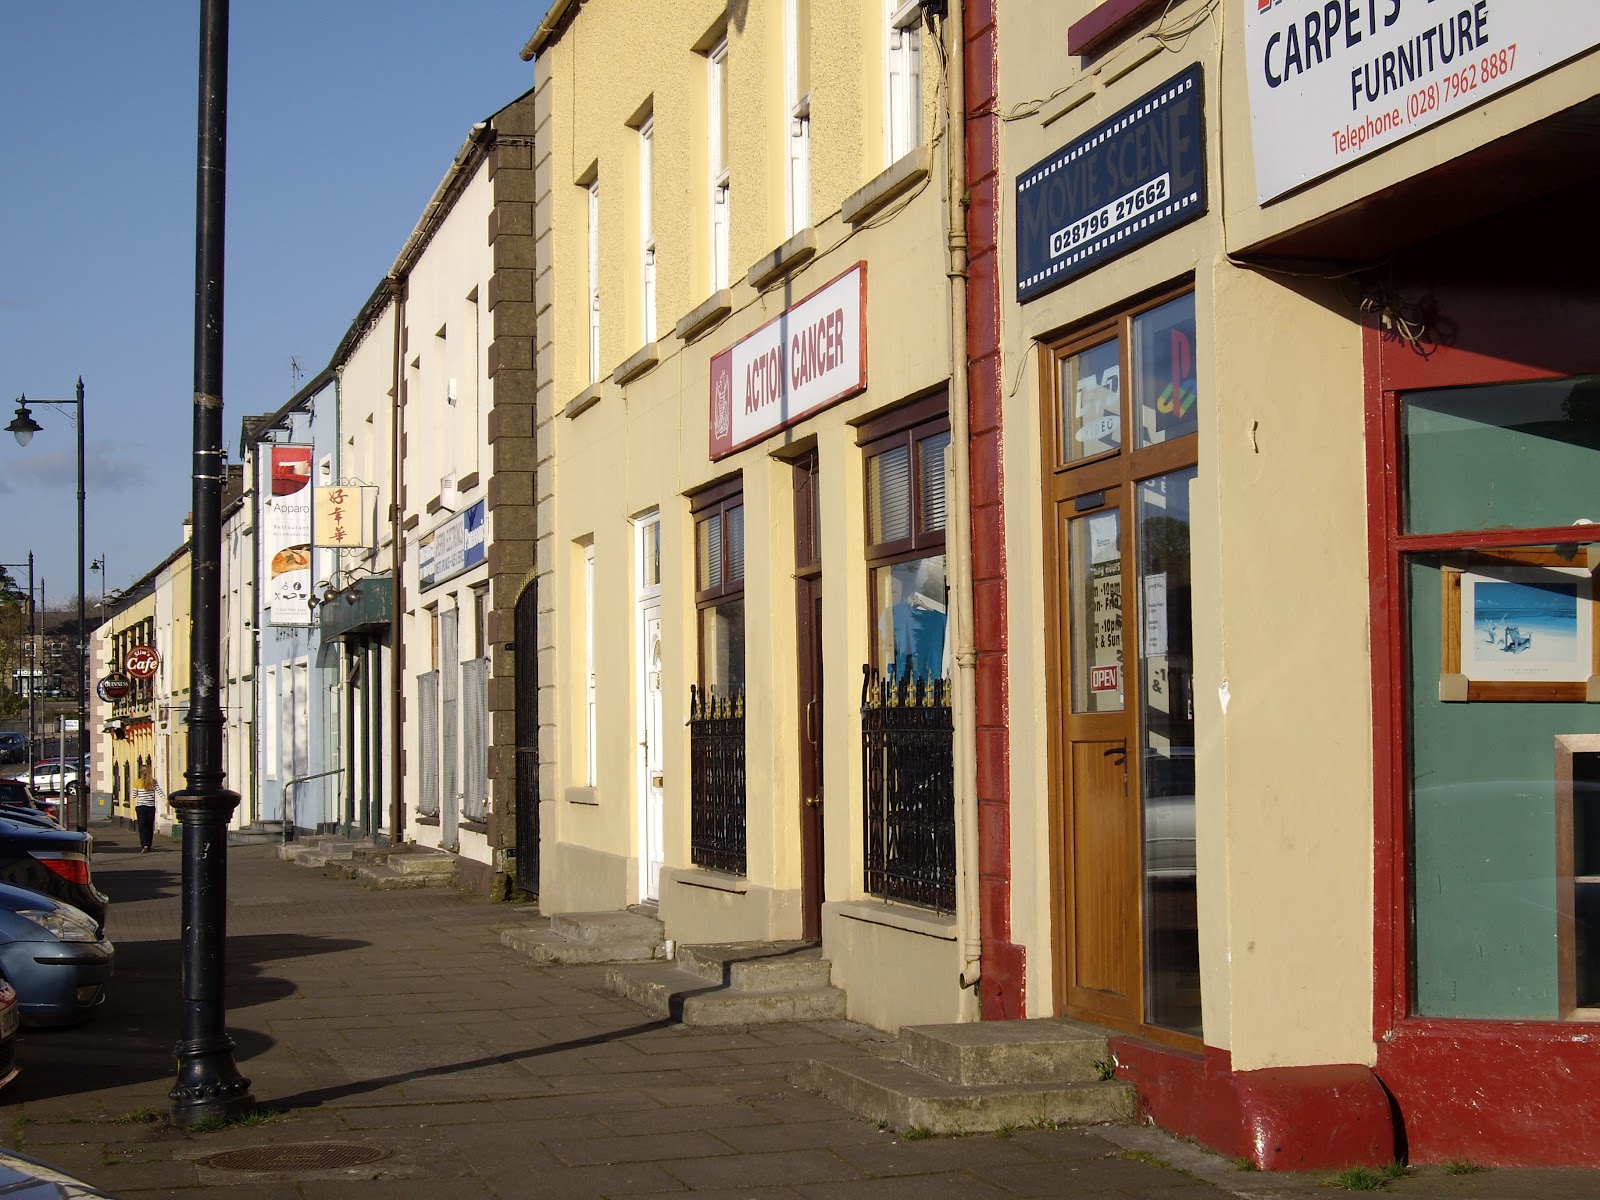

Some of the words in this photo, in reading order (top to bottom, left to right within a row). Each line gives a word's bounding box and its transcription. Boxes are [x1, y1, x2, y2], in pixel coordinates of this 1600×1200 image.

[1265, 0, 1401, 88] CARPETS
[1351, 0, 1489, 111] FURNITURE
[1332, 110, 1404, 155] Telephone.
[1406, 82, 1440, 124] (028)
[1443, 63, 1478, 103] 7962
[1480, 43, 1517, 84] 8887
[1020, 152, 1101, 273] MOVIE
[1106, 97, 1196, 195] SCENE
[1053, 209, 1109, 253] 028796
[1115, 178, 1167, 221] 27662
[745, 343, 786, 416] ACTION
[791, 308, 844, 391] CANCER
[273, 502, 310, 517] Apparo
[127, 657, 158, 674] Cafe
[1107, 633, 1121, 648] Sun
[104, 680, 129, 688] GUINNESS
[1092, 669, 1116, 688] OPEN
